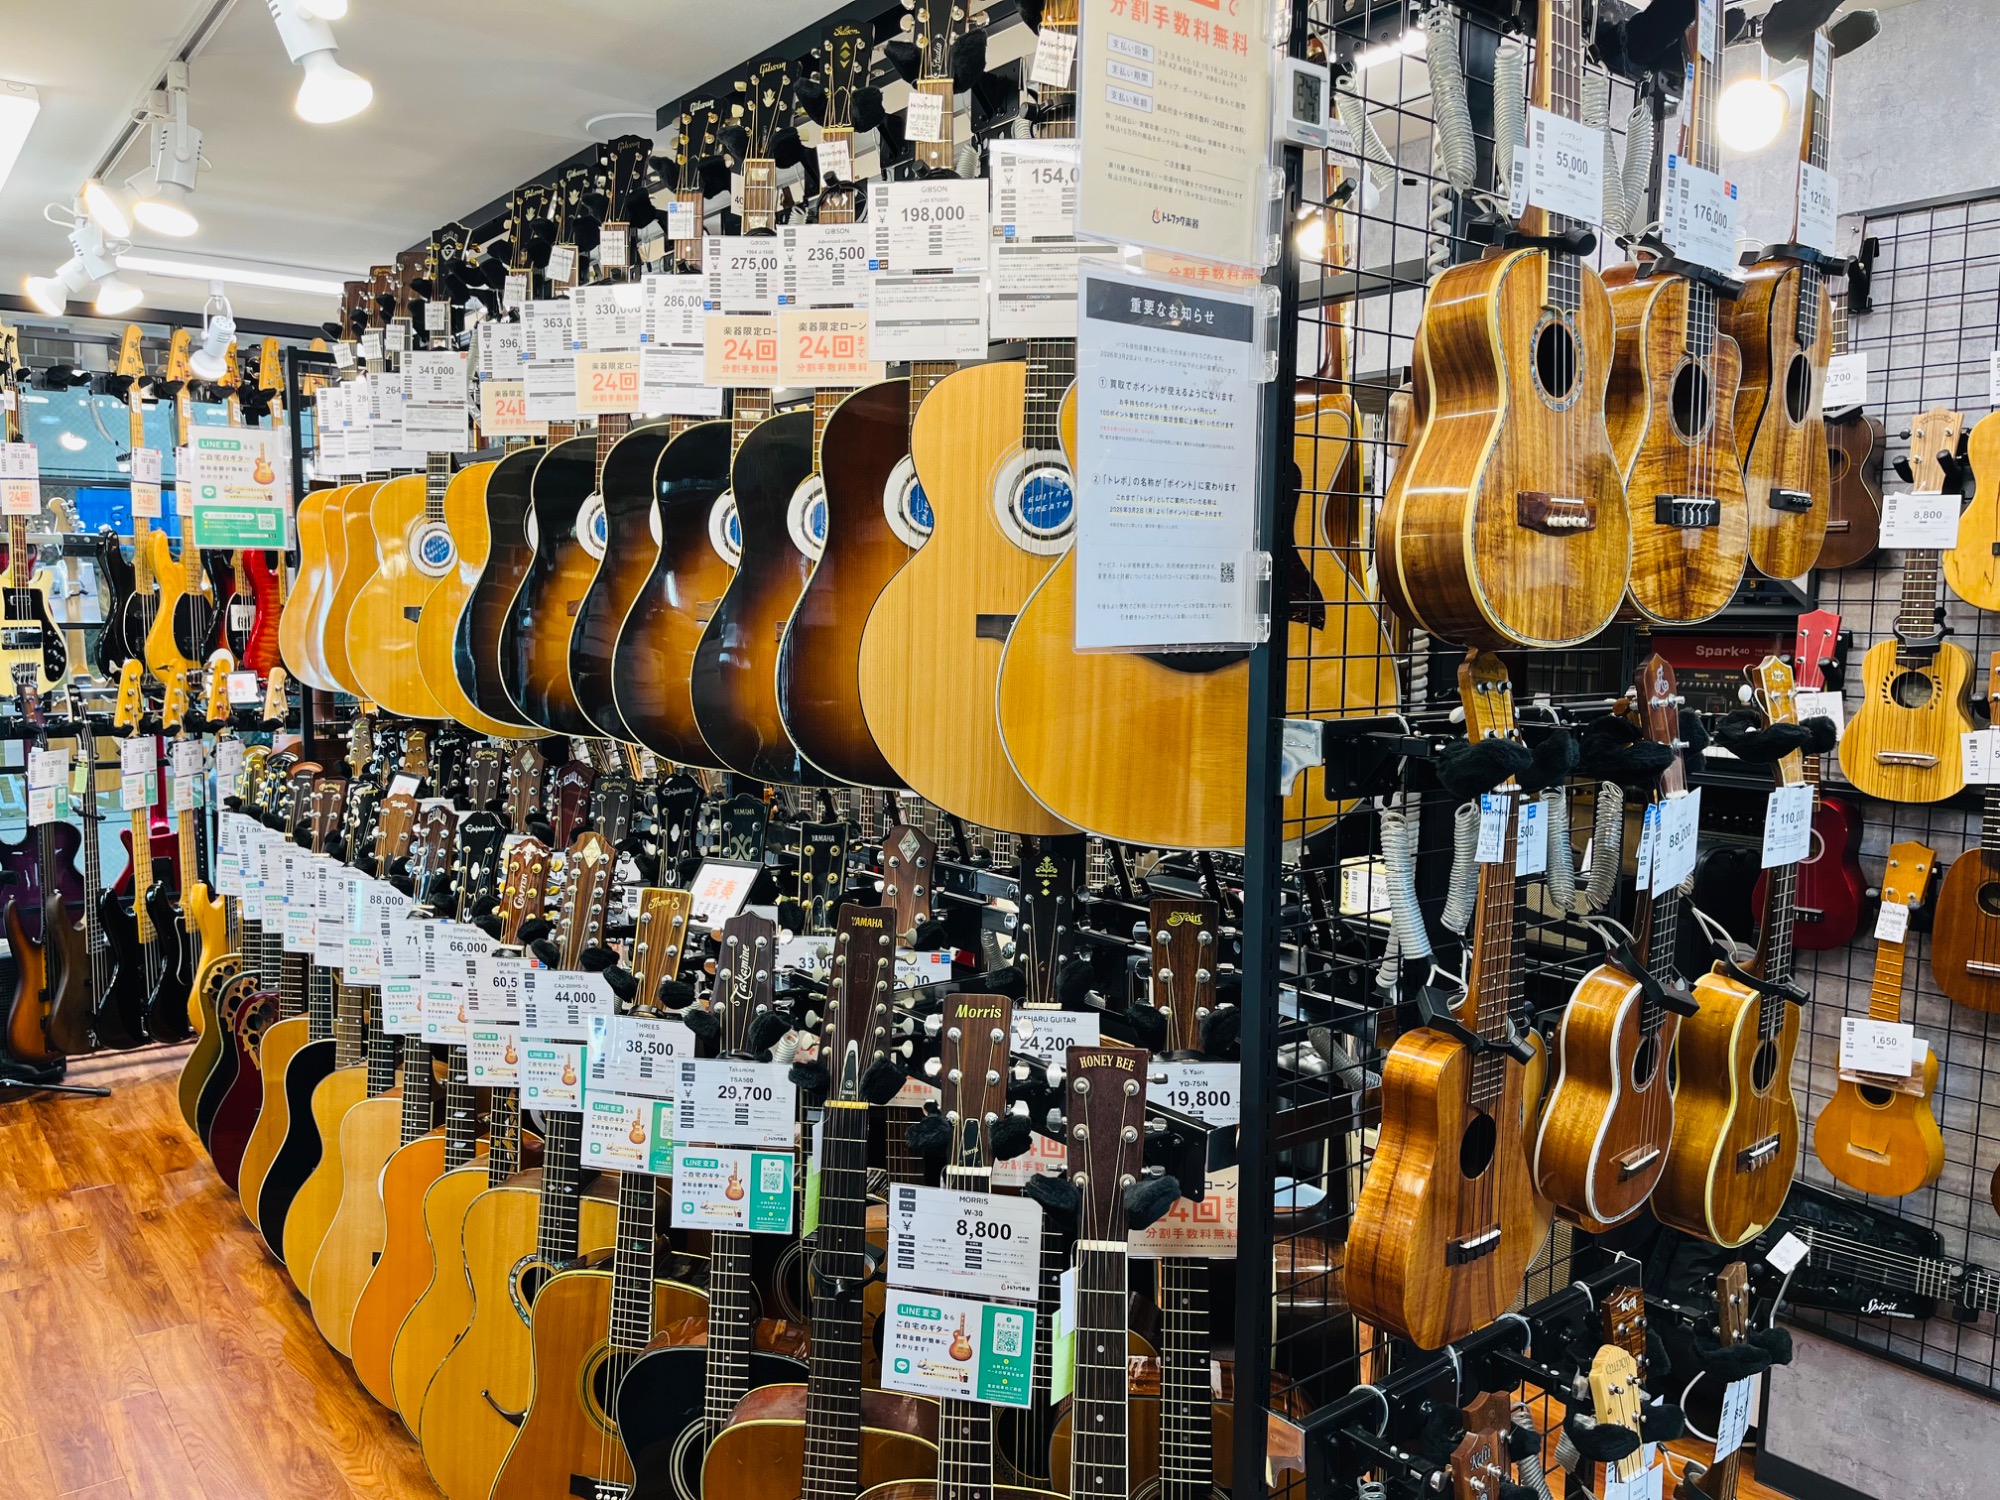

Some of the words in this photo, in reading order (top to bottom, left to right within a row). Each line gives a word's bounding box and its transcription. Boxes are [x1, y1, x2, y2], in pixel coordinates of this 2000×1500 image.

[1109, 0, 1248, 57] 分割手数料無料
[1112, 39, 1149, 58] 支払い回数
[932, 43, 942, 71] Studio
[759, 62, 786, 76] Gibson
[1112, 64, 1149, 83] 支払い期間
[1111, 90, 1147, 108] 支払い総額
[1557, 151, 1588, 175] 55,000
[901, 206, 965, 223] 198,000
[1162, 212, 1199, 229] トレファク楽器
[1694, 203, 1728, 229] 176,000
[807, 246, 865, 262] 236,500
[1130, 296, 1215, 325] 重要なお知らせ
[798, 321, 867, 332] 楽器限定ローン
[724, 339, 776, 361] 24回
[799, 335, 854, 359] 24回
[419, 366, 454, 376] 341,000
[797, 363, 867, 373] 分割手数料無料
[592, 373, 637, 391] 24回
[200, 453, 250, 462] ご自宅のギター
[1027, 487, 1070, 503] GUITAR
[1027, 500, 1070, 515] BREATH
[1914, 510, 1942, 520] 8,800
[1696, 645, 1739, 657] Spark
[662, 787, 694, 796] Epiphone
[734, 808, 755, 816] YAMAHA
[465, 824, 495, 833] Epiphone
[811, 834, 835, 842] YAMAHA
[513, 873, 528, 909] CRAFTER
[370, 896, 404, 906] 88,000
[851, 916, 883, 928] YAMAHA
[450, 941, 487, 954] 66,000
[730, 943, 753, 1006] Takamine
[555, 992, 596, 1005] 44,000
[955, 1004, 1002, 1019] Morris
[635, 1023, 660, 1031] THREES
[1872, 1035, 1897, 1046] 1,650
[626, 1040, 673, 1057] 38,500
[729, 1066, 755, 1074] Takamine
[1079, 1055, 1114, 1069] HONEY
[1115, 1055, 1136, 1071] BEE
[718, 1085, 772, 1102] 29,700
[1167, 1090, 1230, 1109] 19,800
[591, 1114, 630, 1123] ご自宅のギター
[682, 1171, 725, 1179] ご自宅のギター
[959, 1195, 989, 1205] MORRIS
[964, 1208, 983, 1218] W-30
[1160, 1195, 1221, 1223] 4回
[903, 1220, 911, 1231] ¥
[956, 1219, 1012, 1240] 8,800
[1146, 1228, 1238, 1240] 分割手数料無料
[1861, 1298, 1897, 1314] Spirit
[896, 1320, 950, 1332] ご自宅のギター
[896, 1333, 947, 1345] 買取金額が簡単に
